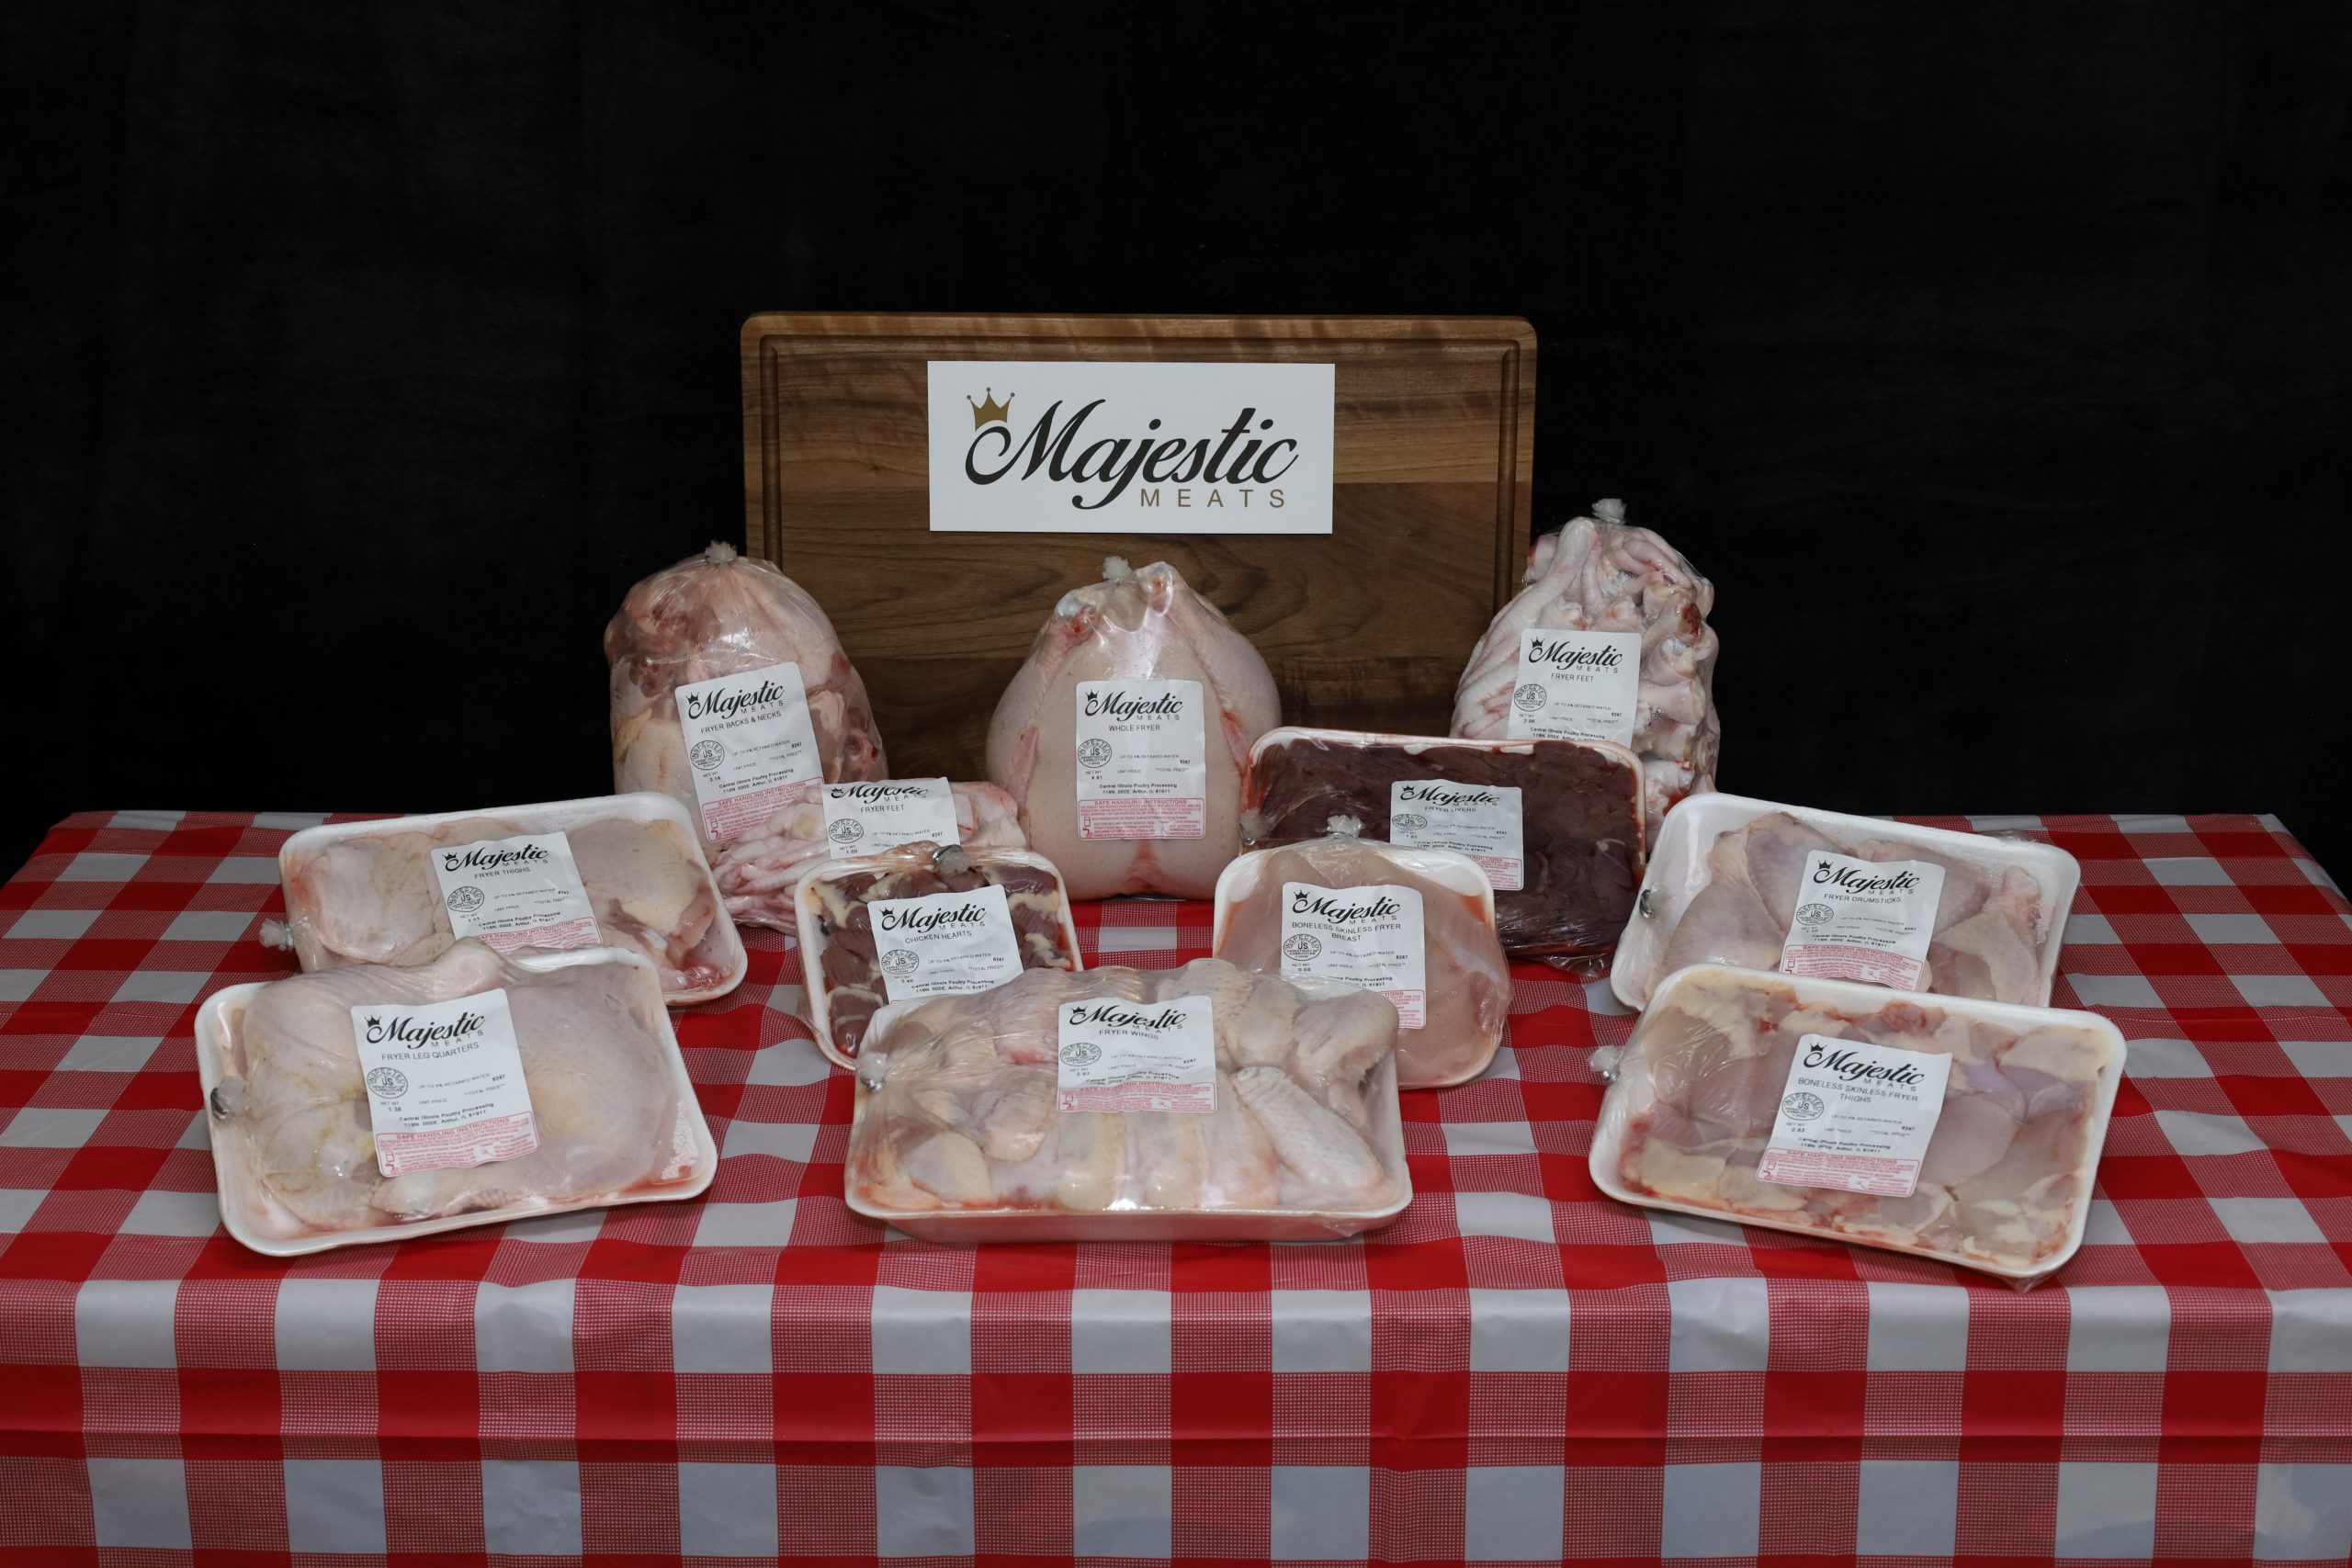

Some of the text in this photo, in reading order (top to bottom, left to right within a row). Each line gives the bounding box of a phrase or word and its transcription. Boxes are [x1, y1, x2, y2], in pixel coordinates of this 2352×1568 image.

[965, 399, 1298, 510] Majestic
[1140, 489, 1285, 508] MEATS
[1528, 640, 1623, 671] Majestic
[1551, 672, 1594, 682] FRYER FEET
[1576, 664, 1619, 674] MEATS
[688, 680, 785, 720] Majestic
[741, 700, 785, 716] MEATS
[1084, 691, 1183, 722] Majestic
[700, 723, 725, 735] FRYER
[725, 717, 750, 729] BACKS
[757, 710, 782, 721] NECKS
[1136, 713, 1181, 721] MEATS
[1108, 724, 1160, 732] WHOLE FRYER
[733, 791, 763, 801] HANDLING
[764, 782, 807, 795] INSTRUCTIONS
[831, 784, 929, 804] Majestic
[1399, 785, 1500, 806] Majestic
[860, 804, 904, 813] FRYER FEET
[445, 844, 548, 872] Majestic
[474, 867, 531, 879] FRYER THIGHS
[1813, 866, 1920, 894] Majestic
[1824, 893, 1902, 904] FRYER DRUMSTICKS
[881, 903, 987, 933] Majestic
[1292, 896, 1401, 924] Majestic
[938, 921, 986, 931] MEATS
[1292, 921, 1401, 935] BONELESS SKINLESS FRYER
[1349, 915, 1397, 925] MEATS
[904, 930, 972, 944] CHICKEN HEARTS
[1331, 932, 1361, 942] BREAST
[1069, 1005, 1187, 1029] Majestic
[367, 1011, 485, 1050] Majestic
[1130, 1030, 1159, 1040] WINGS
[1132, 1023, 1183, 1033] MEATS
[431, 1030, 484, 1048] MEATS
[381, 1042, 480, 1061] FRYER LEG QUARTERS
[1803, 1049, 1925, 1085] Majestic
[1797, 1077, 1918, 1102] BONELESS SKINLESS FRYER
[1863, 1077, 1917, 1092] MEATS
[1840, 1093, 1872, 1103] THIGHS
[396, 1118, 510, 1141] SAFE HANDLING INSTRUCTIONS
